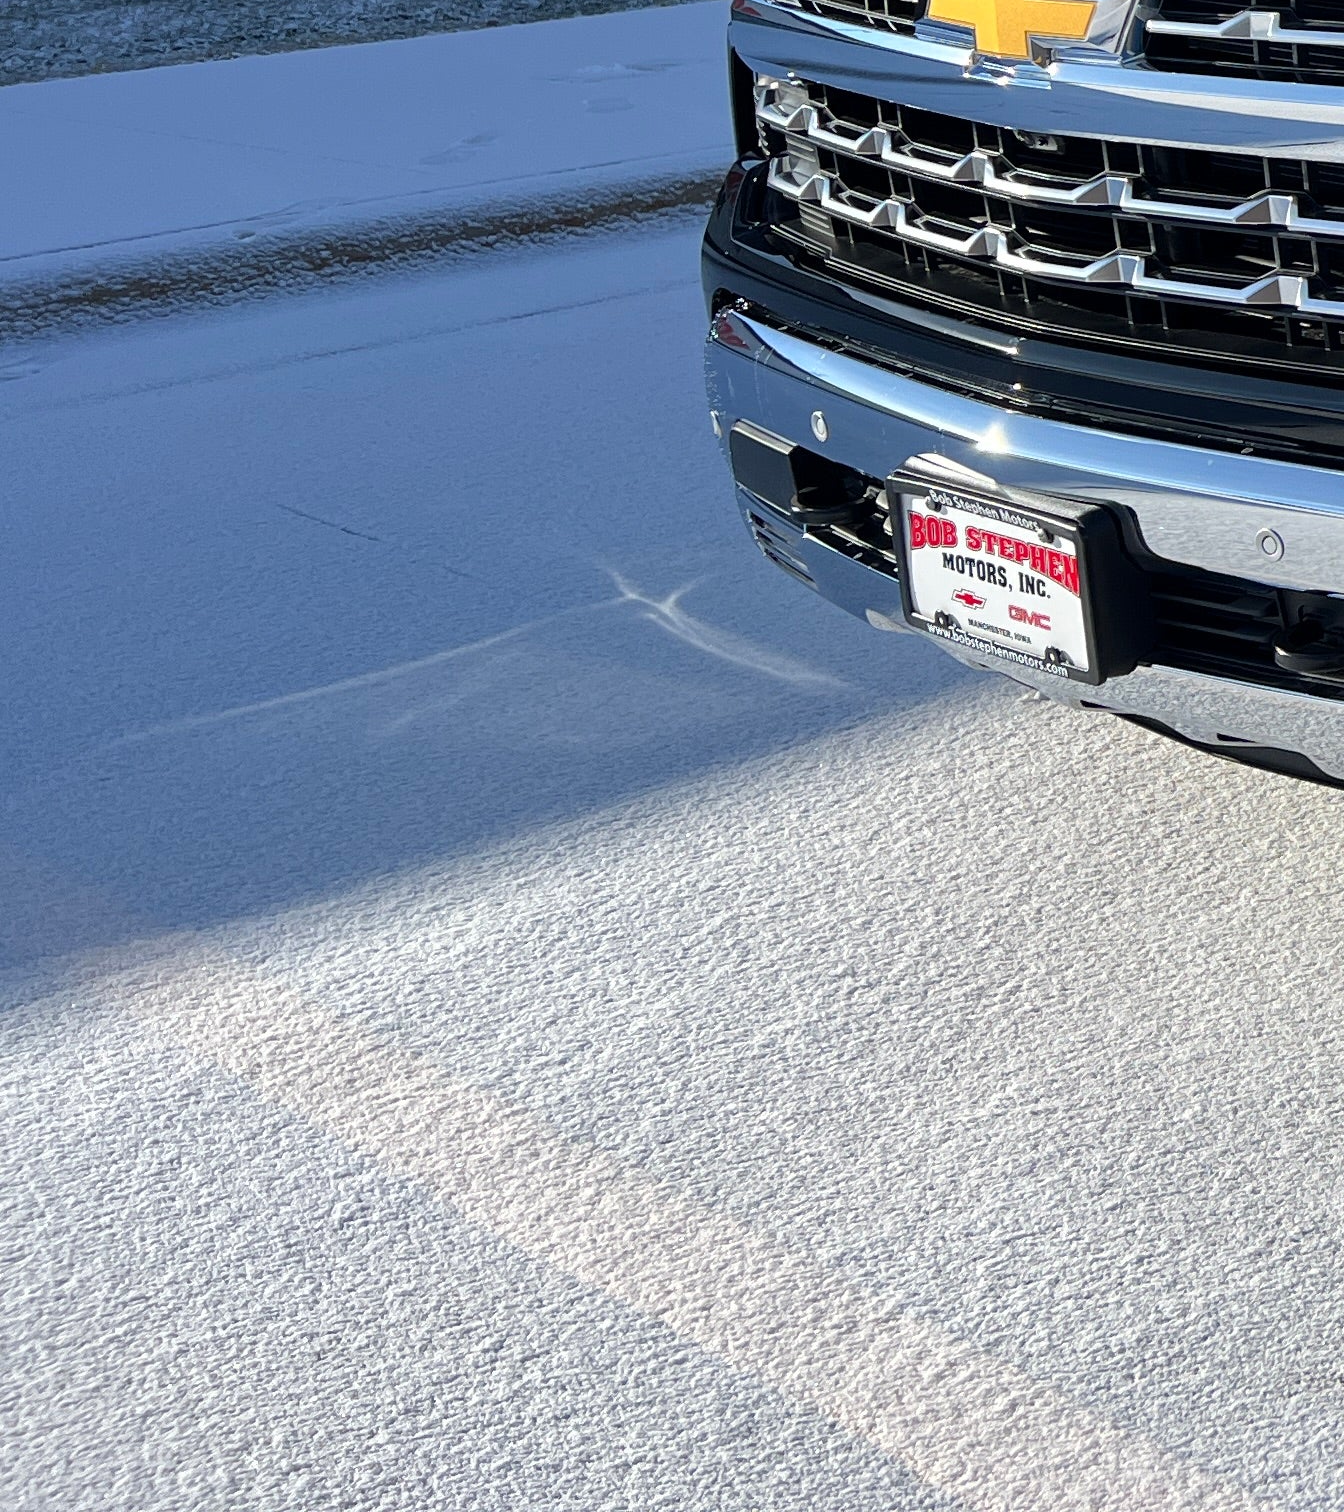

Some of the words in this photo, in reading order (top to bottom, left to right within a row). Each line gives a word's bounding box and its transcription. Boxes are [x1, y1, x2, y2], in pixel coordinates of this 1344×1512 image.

[928, 489, 953, 506] Bob
[953, 496, 999, 520] Stephen
[999, 509, 1039, 531] Motors
[909, 511, 958, 550] BOB
[965, 525, 1081, 597] STEPHEN
[941, 552, 1013, 592] MOTORS,
[1018, 571, 1051, 599] INC.
[1008, 604, 1051, 631] GMC
[926, 622, 1069, 678] www.bobstephenmotors.com
